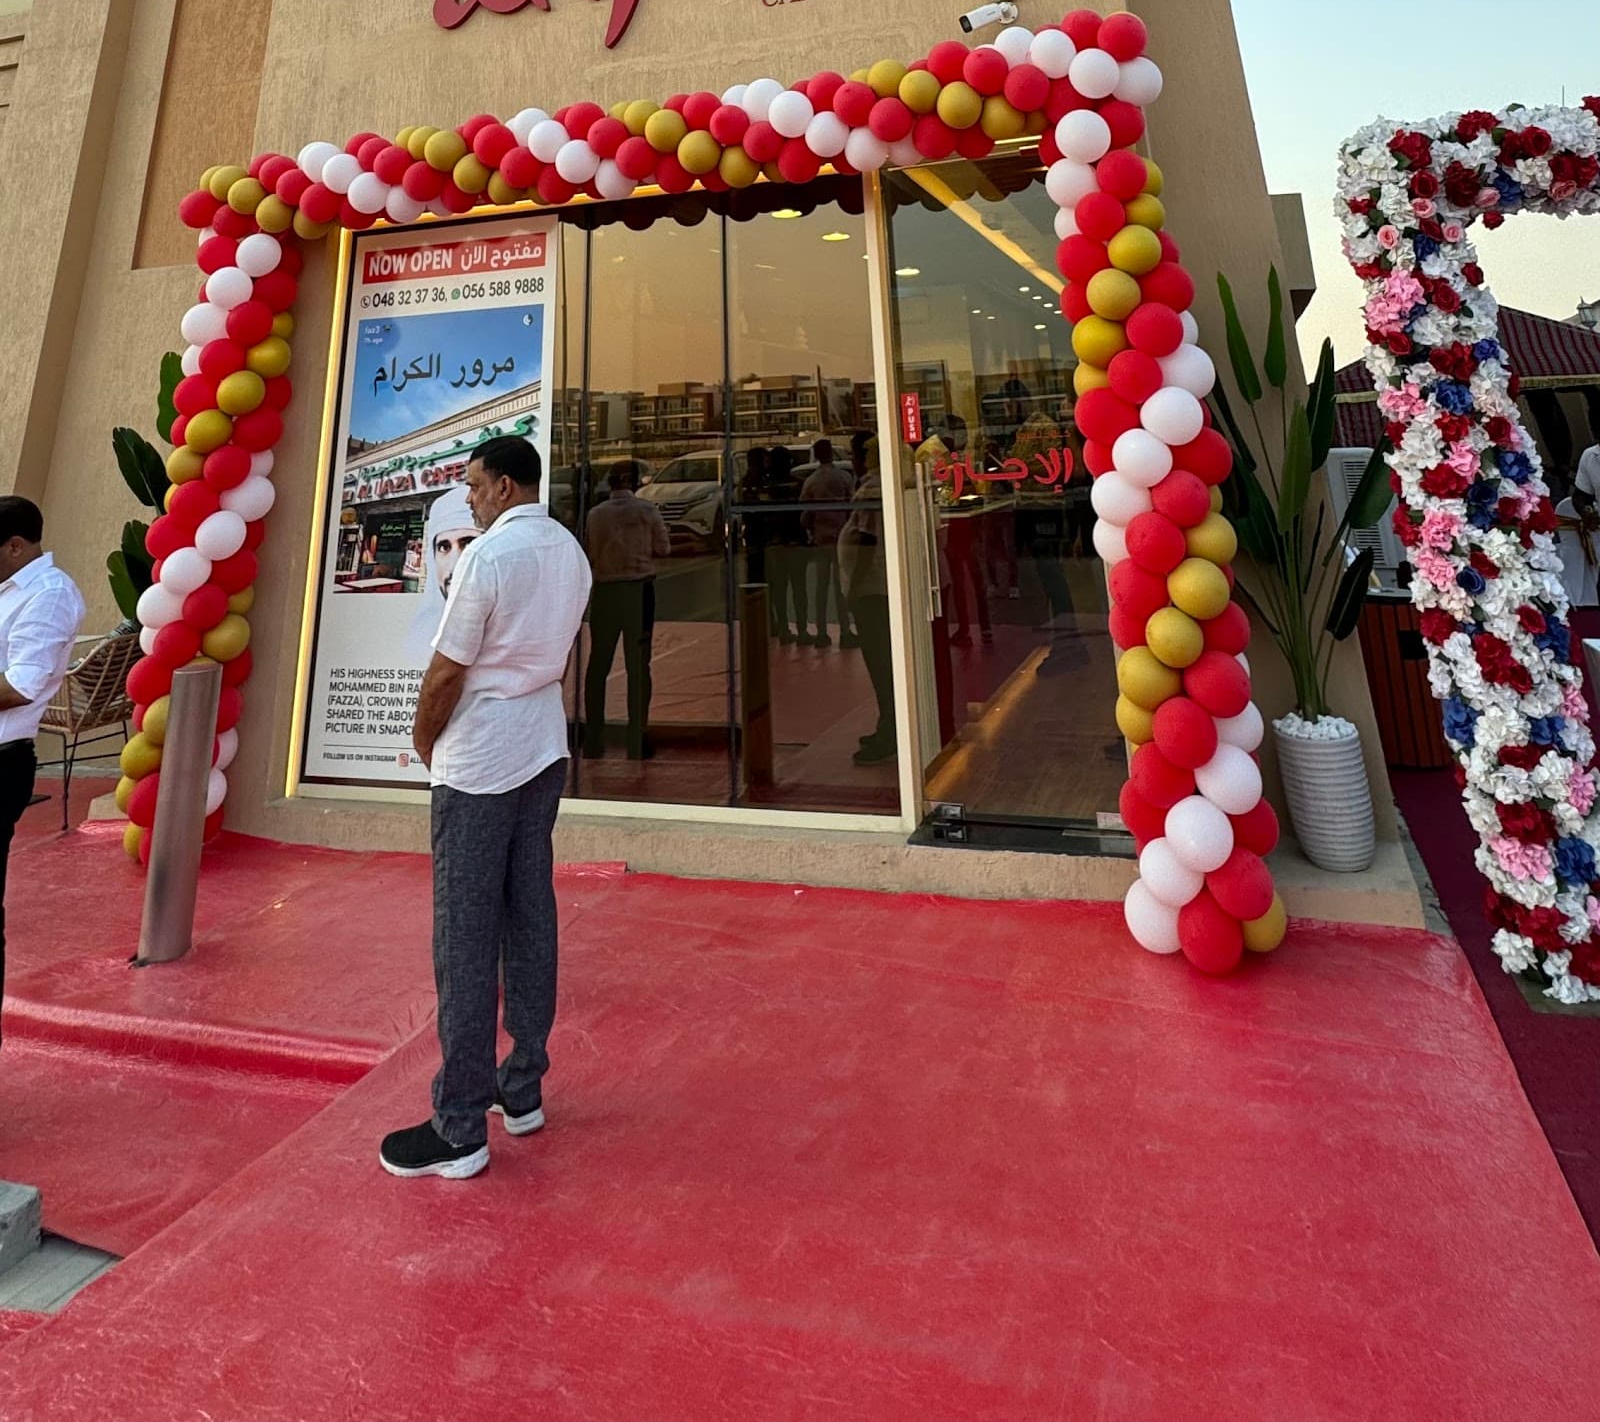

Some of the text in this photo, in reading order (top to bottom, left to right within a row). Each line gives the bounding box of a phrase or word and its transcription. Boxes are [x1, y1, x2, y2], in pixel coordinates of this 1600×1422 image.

[368, 248, 453, 277] NOW OPEN
[489, 241, 543, 268] مفتوح
[372, 291, 394, 308] 048
[398, 289, 411, 305] 32
[415, 288, 429, 304] 37
[462, 283, 485, 300] 056
[489, 280, 511, 297] 588
[515, 277, 545, 295] 9888
[374, 352, 515, 398] مرور الكرام
[907, 407, 917, 440] PUSH
[420, 459, 471, 488] CAFE
[330, 668, 425, 680] HIS HIGHNESS SHEIK
[329, 681, 420, 694] MOHAMMED BIN RA
[327, 694, 418, 707] (FAZZA), CROWN PR
[326, 708, 416, 722] SHARED THE ABOV
[325, 722, 414, 736] PICTURE IN SNAPC
[323, 752, 346, 761] FOLLOW
[355, 753, 363, 761] ON
[364, 754, 397, 762] INSTAGRAM
